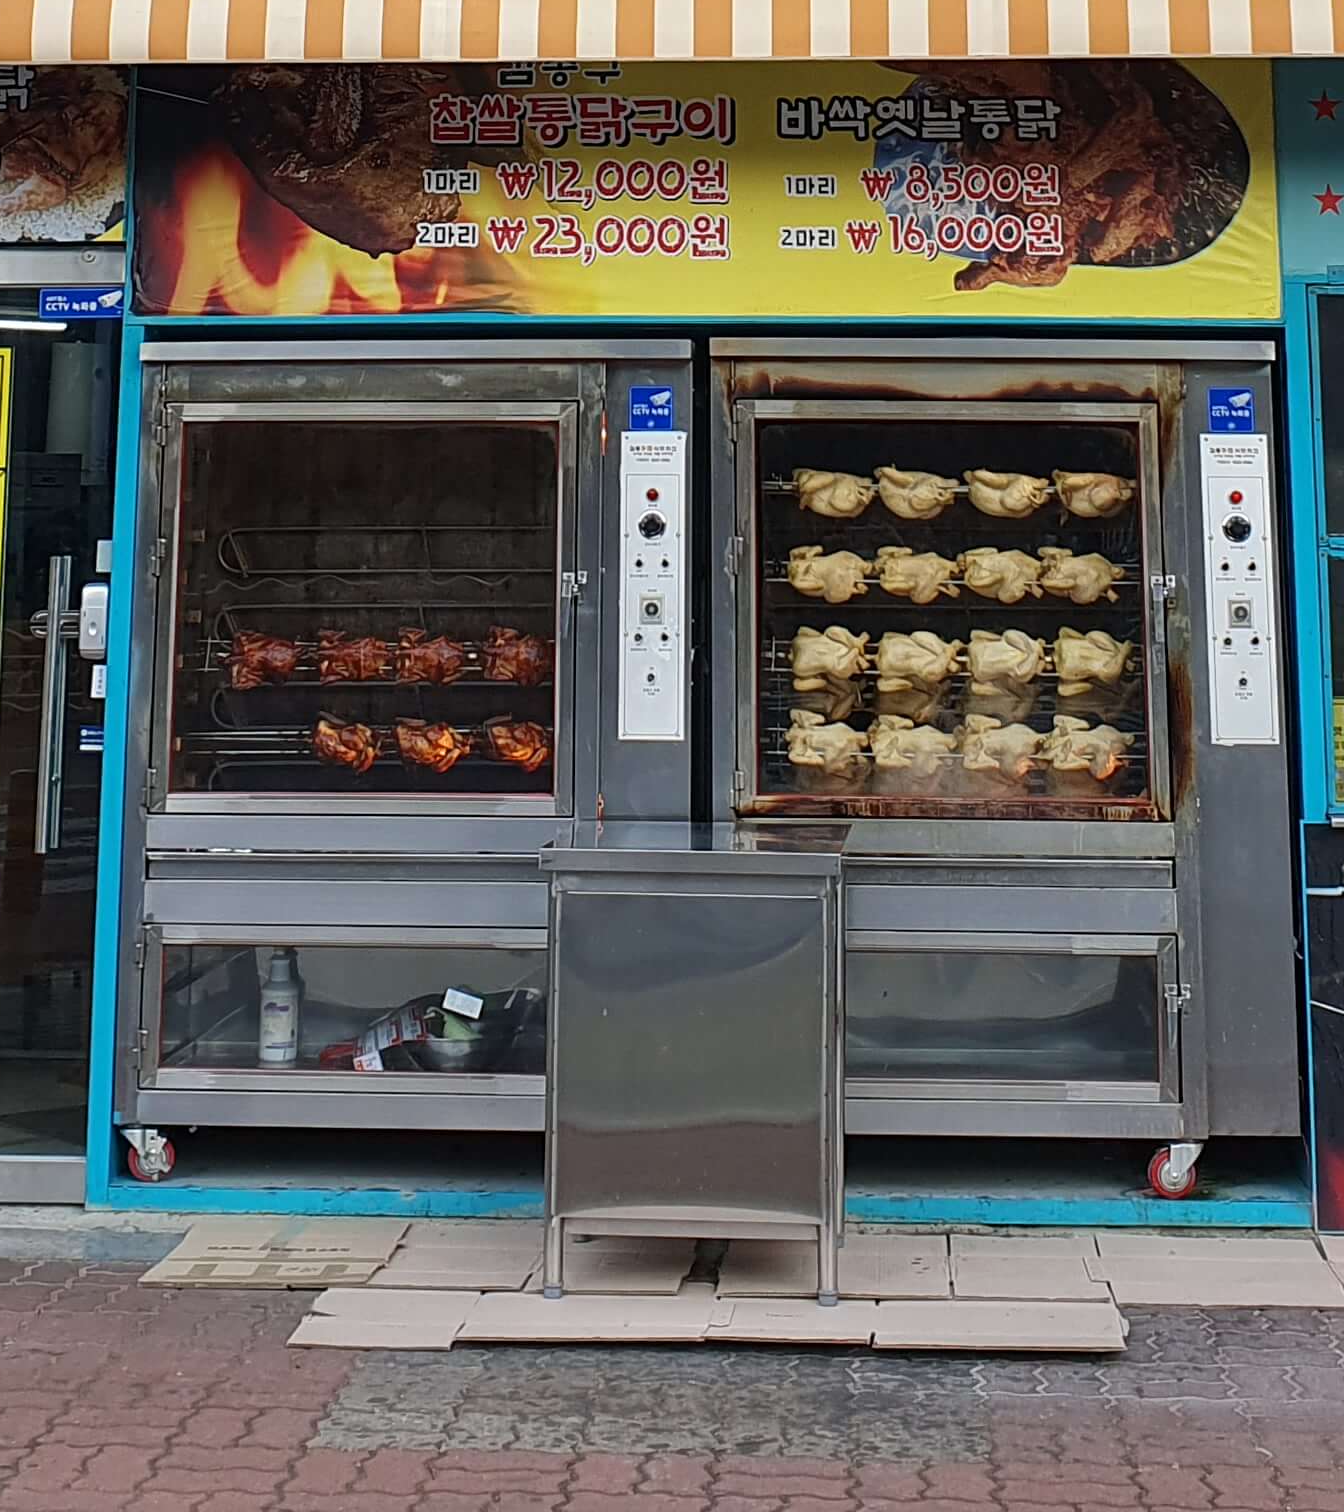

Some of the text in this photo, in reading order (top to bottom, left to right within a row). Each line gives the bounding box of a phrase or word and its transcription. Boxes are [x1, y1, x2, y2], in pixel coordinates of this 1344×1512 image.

[429, 94, 736, 146] 찹쌀통닭구이
[776, 96, 1061, 142] 바싹옛날통닭
[423, 170, 480, 195] 1마리
[785, 175, 837, 198] 1마리
[416, 222, 479, 249] 2마리
[781, 227, 837, 250] 2마리
[45, 303, 70, 311] CCTV
[633, 408, 650, 416] CCTV
[1212, 409, 1230, 417] CCTV
